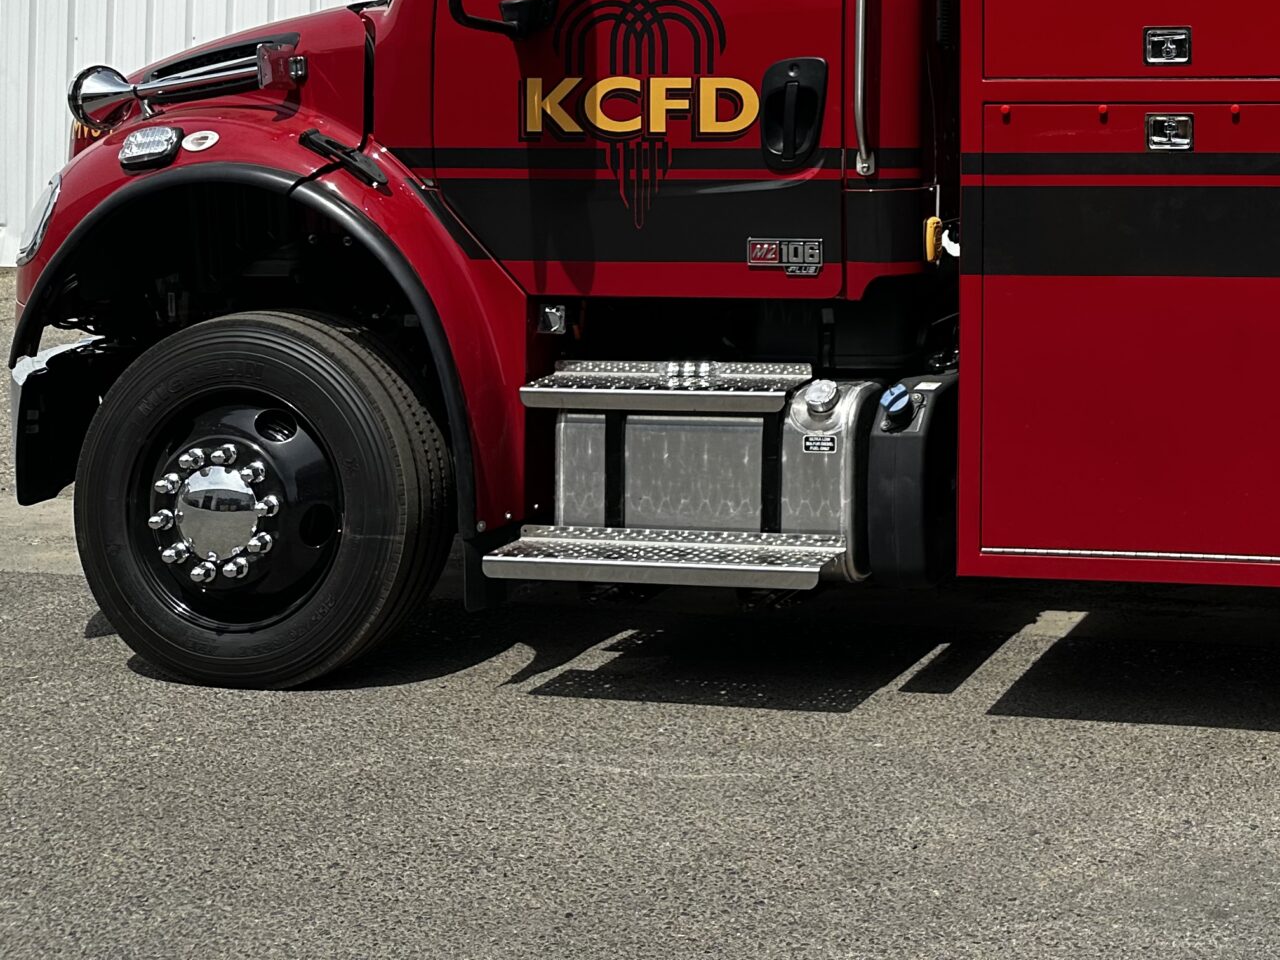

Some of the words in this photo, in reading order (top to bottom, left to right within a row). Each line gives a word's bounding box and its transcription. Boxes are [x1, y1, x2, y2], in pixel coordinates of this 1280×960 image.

[525, 76, 761, 133] KCFD
[752, 243, 777, 259] M2
[780, 242, 820, 263] 106
